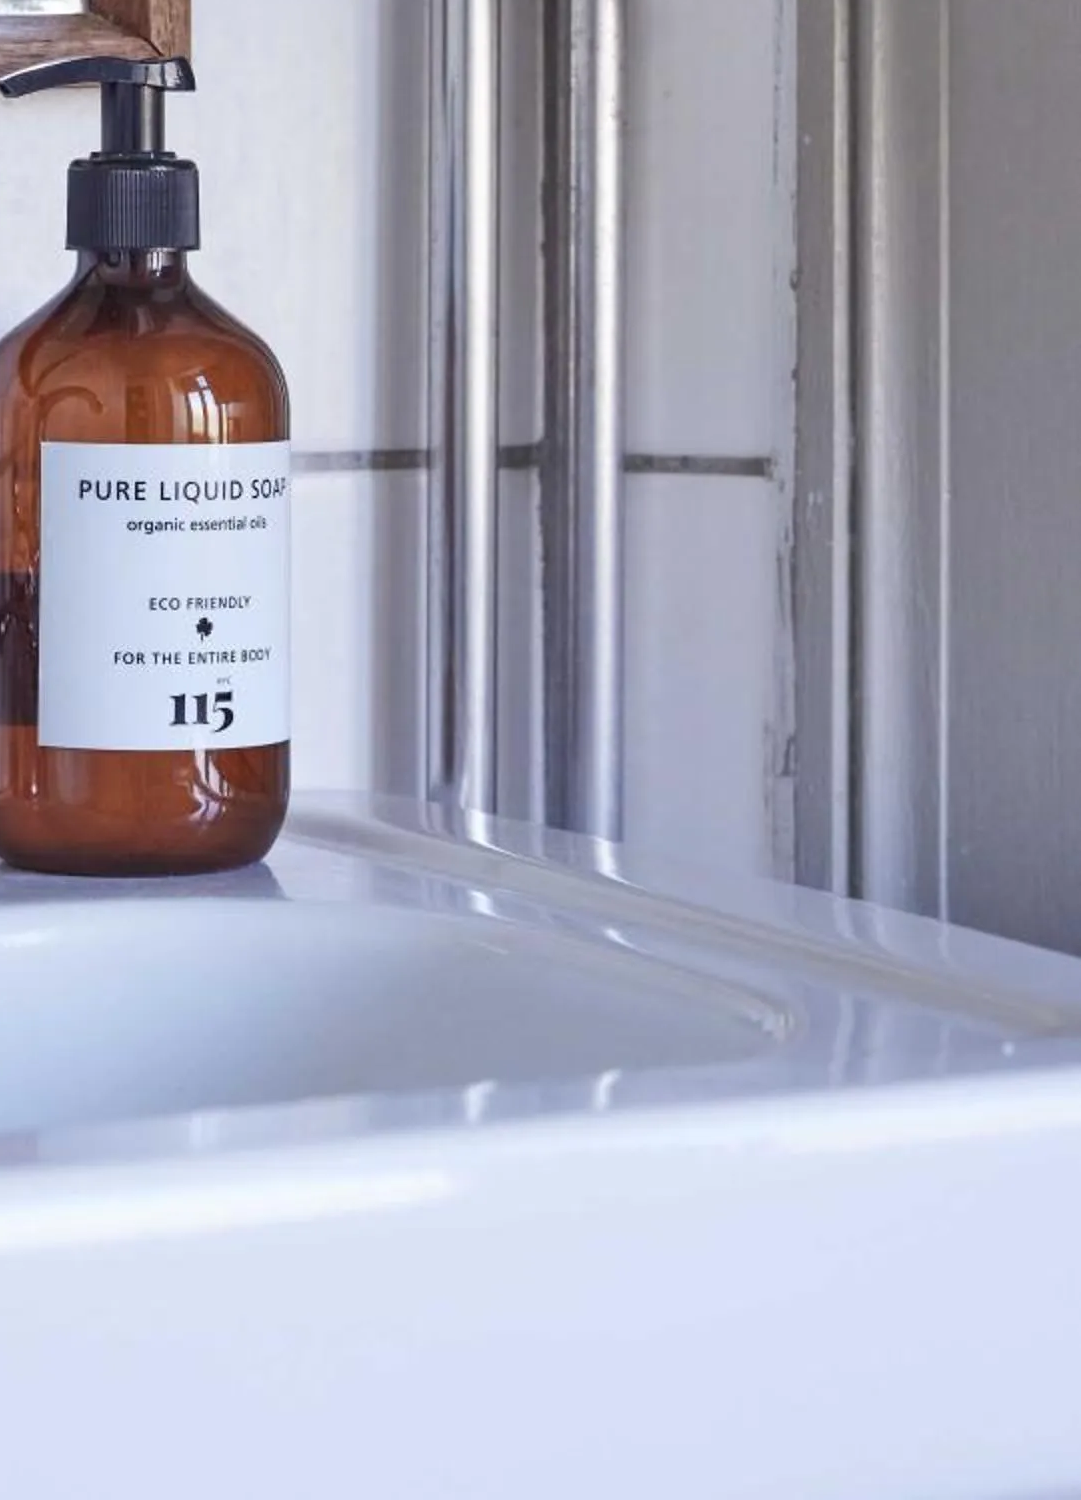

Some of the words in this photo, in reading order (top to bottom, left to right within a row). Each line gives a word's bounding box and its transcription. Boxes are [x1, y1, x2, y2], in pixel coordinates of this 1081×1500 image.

[79, 480, 147, 501] PURE
[160, 480, 244, 504] LIQUID
[126, 518, 185, 535] organic
[190, 516, 247, 531] essential
[250, 515, 267, 529] oils
[149, 597, 180, 611] ECO
[186, 596, 251, 610] FRIENDLY
[114, 651, 145, 665] FOR
[153, 651, 181, 665] THE
[188, 650, 236, 664] ENTIRE
[241, 647, 272, 662] BODY
[169, 691, 234, 733] 115
